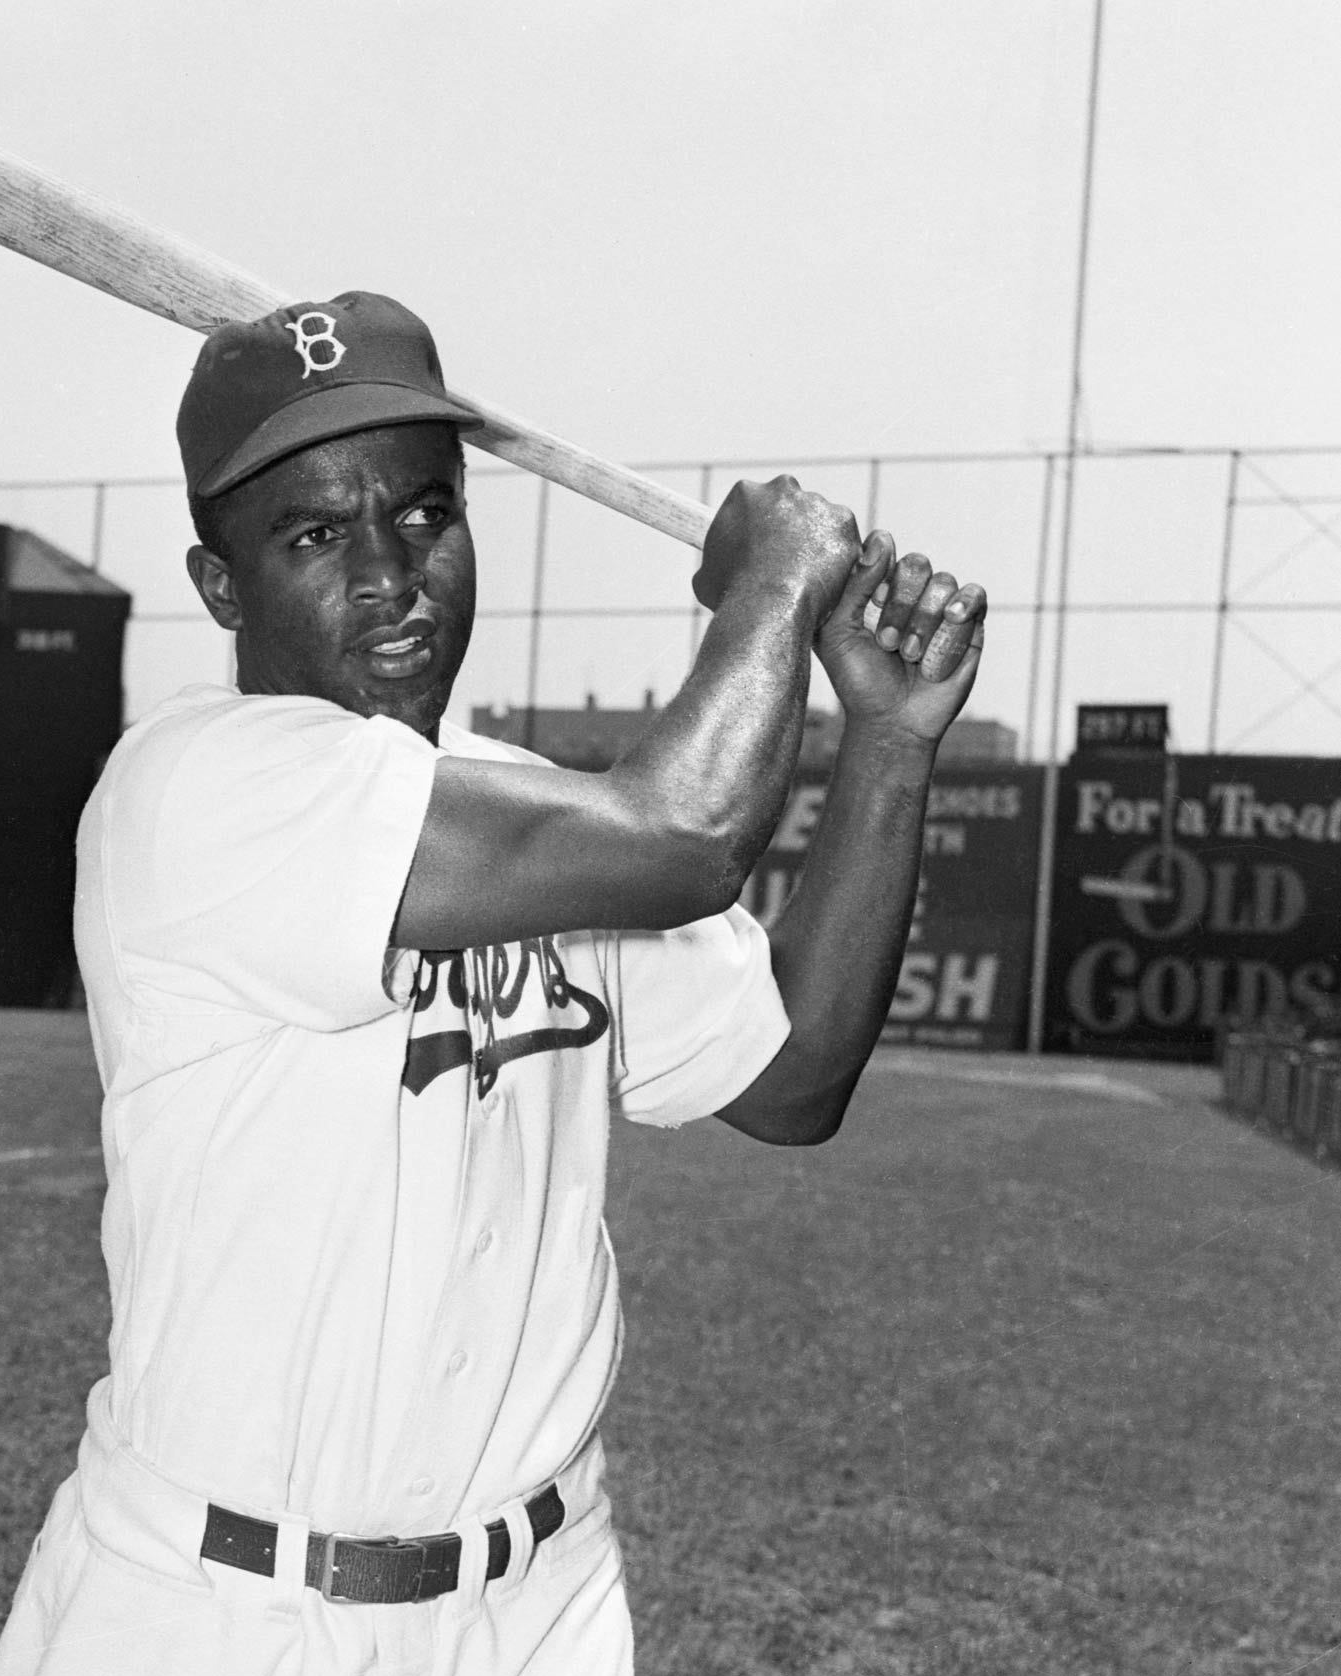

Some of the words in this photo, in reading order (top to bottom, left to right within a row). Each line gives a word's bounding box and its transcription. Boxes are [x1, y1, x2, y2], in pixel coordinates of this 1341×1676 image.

[285, 311, 348, 380] B
[1076, 781, 1159, 835] For
[1177, 800, 1208, 838] a
[1116, 842, 1308, 939] OLD
[1063, 938, 1337, 1032] GOLDS
